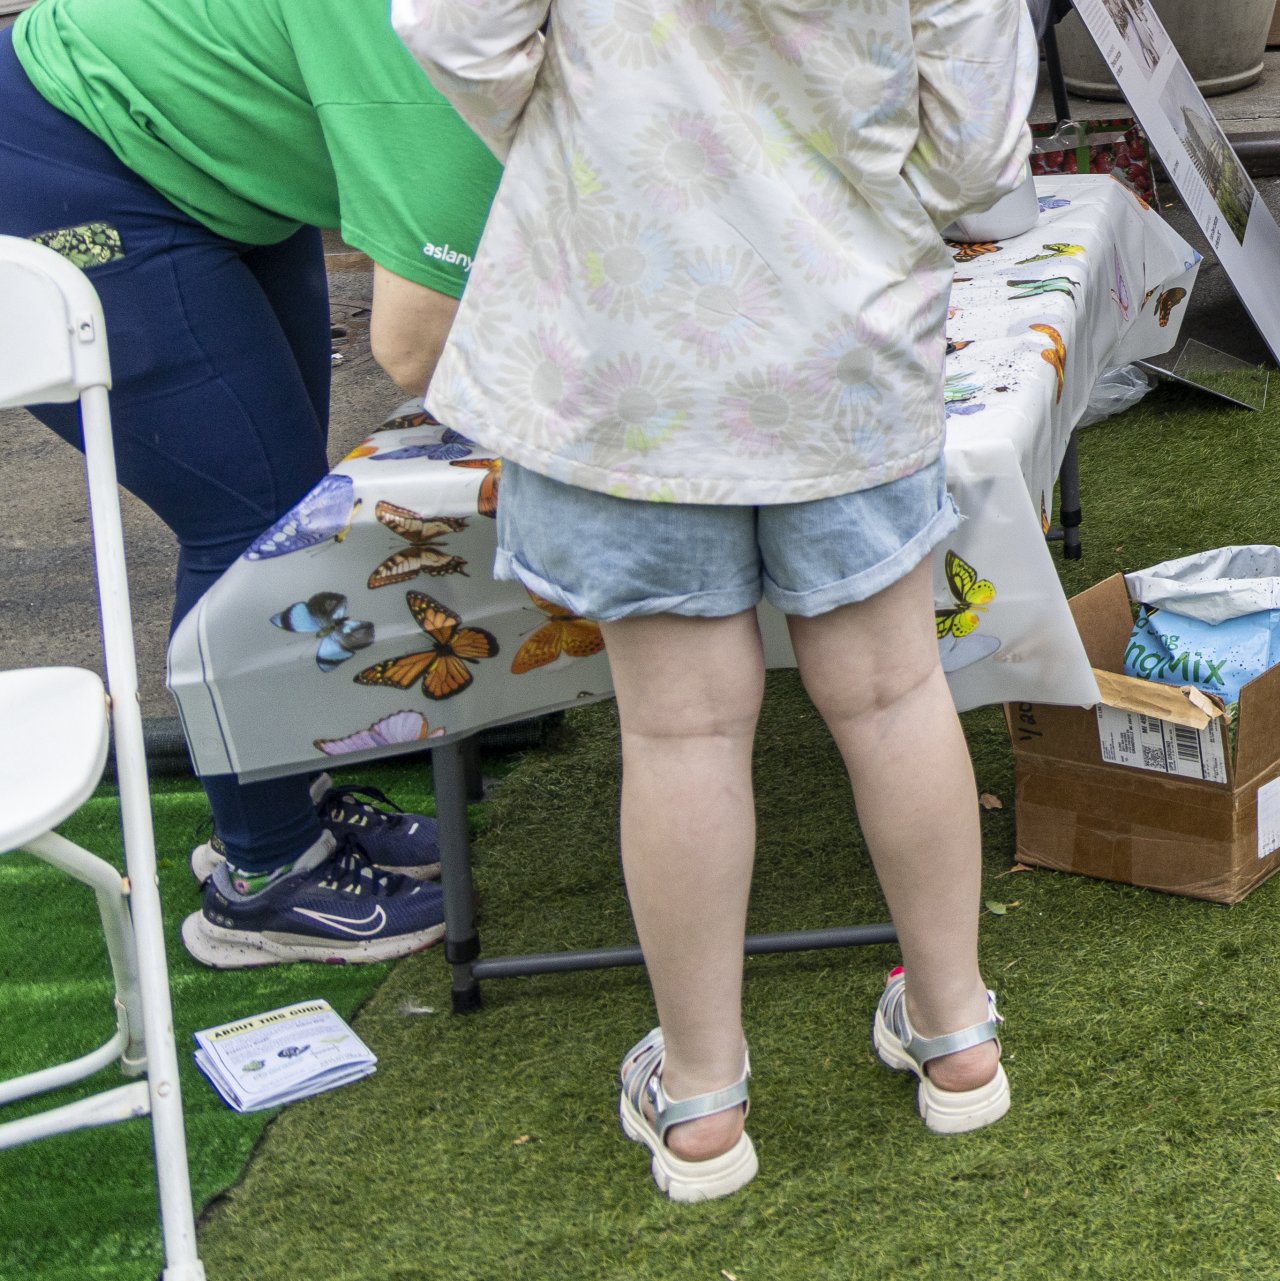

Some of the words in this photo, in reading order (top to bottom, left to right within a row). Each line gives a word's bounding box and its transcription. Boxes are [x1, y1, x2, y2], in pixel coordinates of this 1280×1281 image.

[214, 1020, 254, 1040] ABOUT
[260, 1013, 286, 1027] THIS
[290, 1003, 327, 1019] GUIDE
